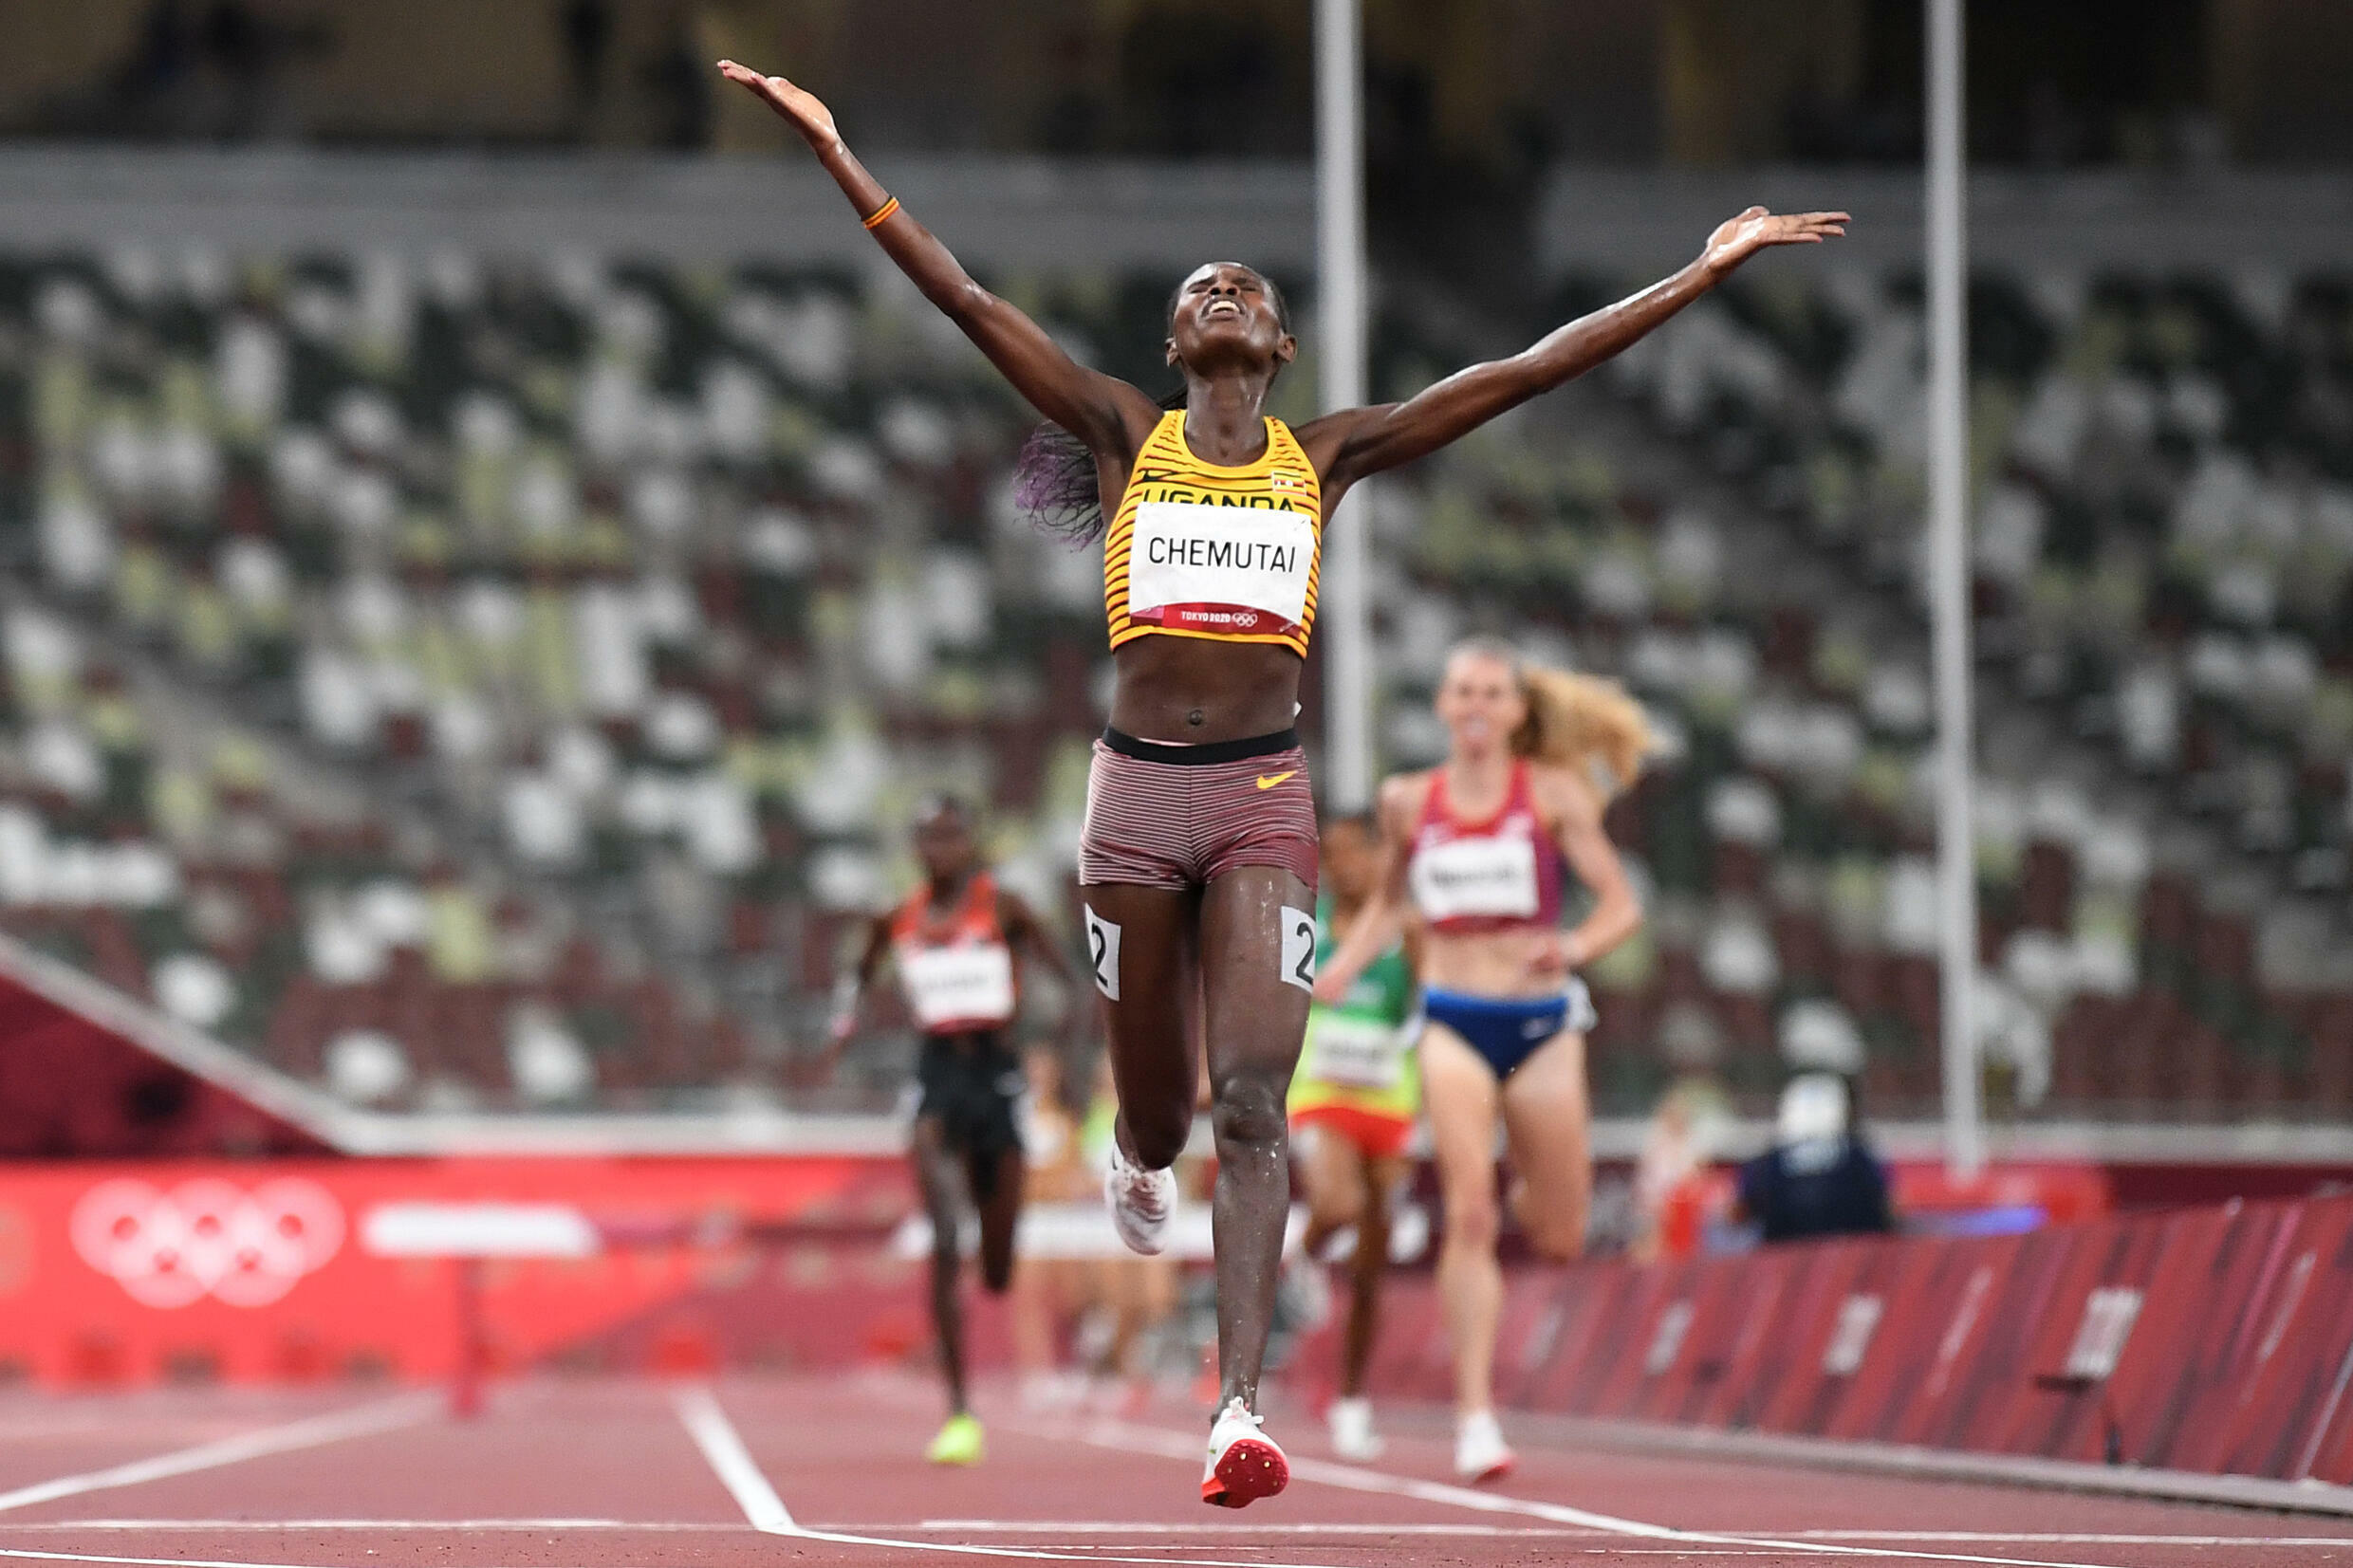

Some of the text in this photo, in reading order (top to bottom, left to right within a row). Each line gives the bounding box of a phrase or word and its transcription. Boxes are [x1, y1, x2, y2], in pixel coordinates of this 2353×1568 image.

[1149, 537, 1296, 573] CHEMUTAI
[1181, 611, 1232, 623] TOKYO 2020
[1091, 922, 1108, 988] 2
[1295, 921, 1316, 986] 2
